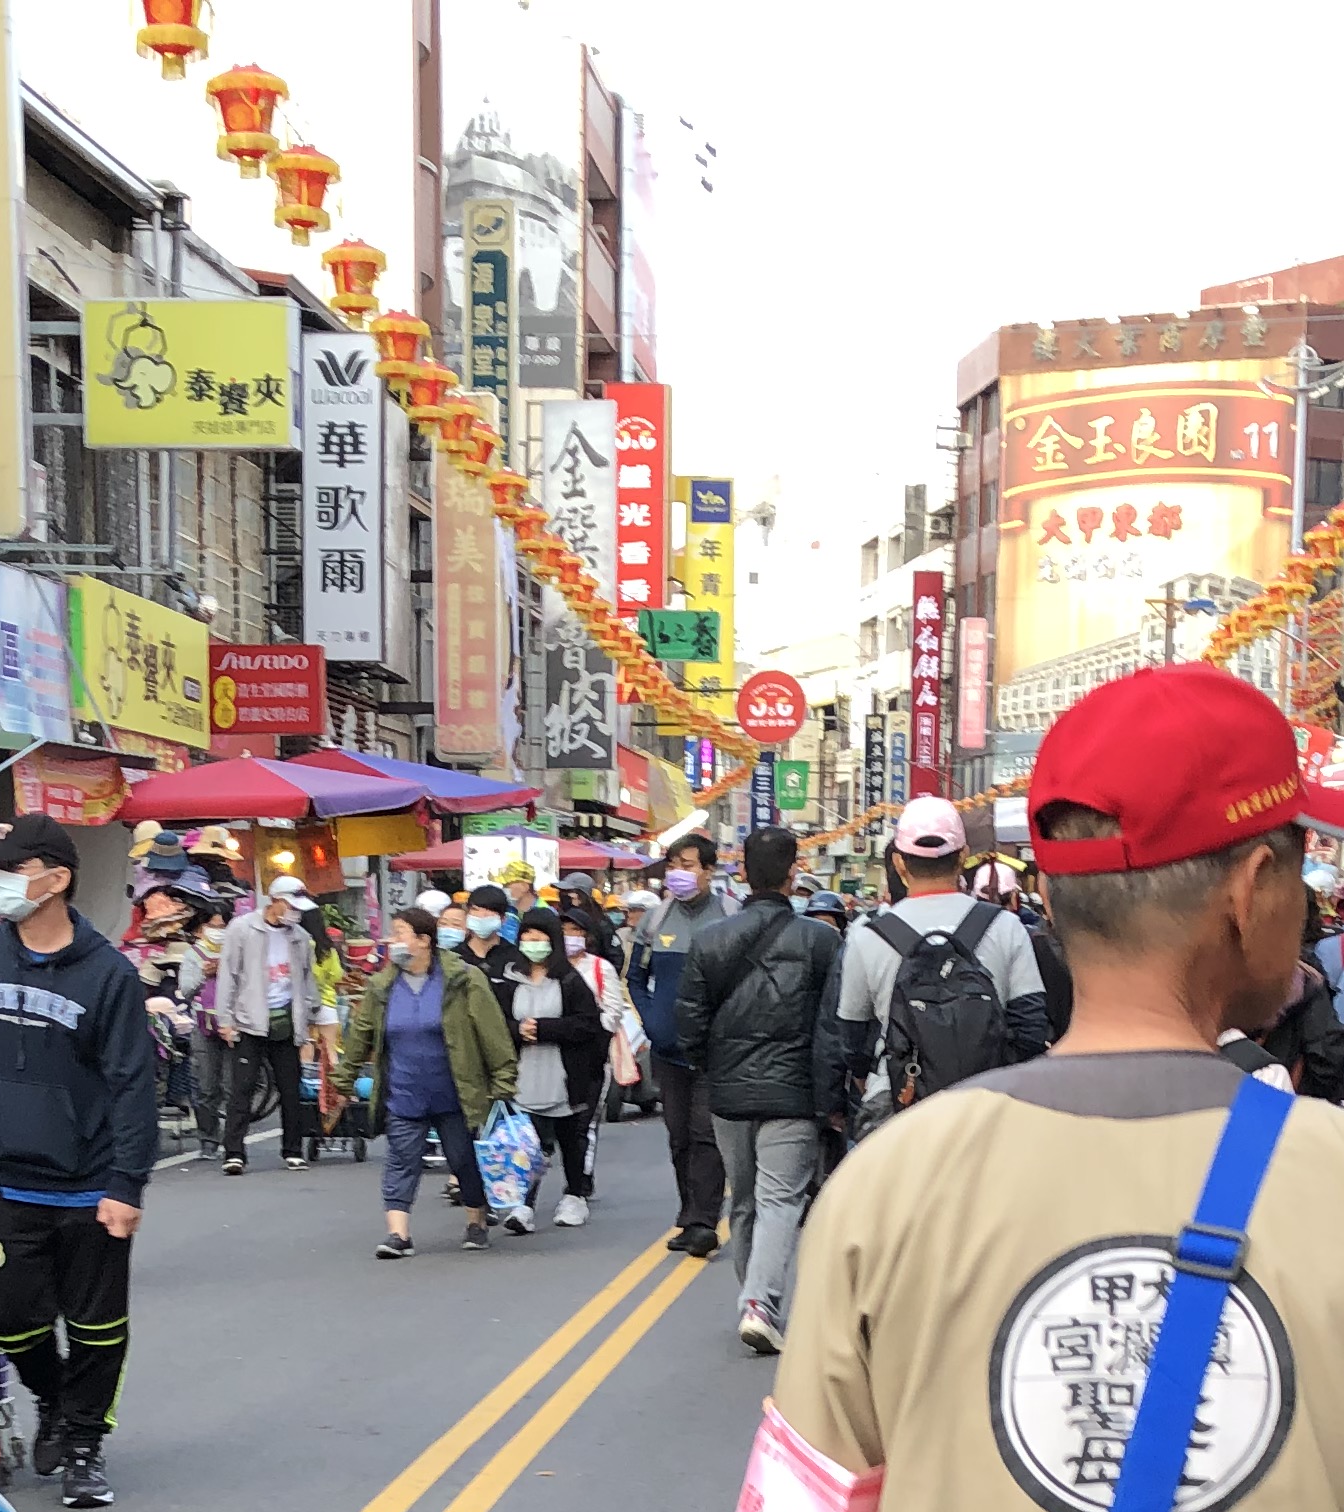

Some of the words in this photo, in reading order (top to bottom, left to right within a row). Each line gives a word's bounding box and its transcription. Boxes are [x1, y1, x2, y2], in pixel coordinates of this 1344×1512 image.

[1027, 402, 1218, 472] 金玉良園
[316, 421, 369, 595] 華歌爾
[618, 464, 652, 628] 繼光香香
[213, 652, 309, 671] SHISEIDO
